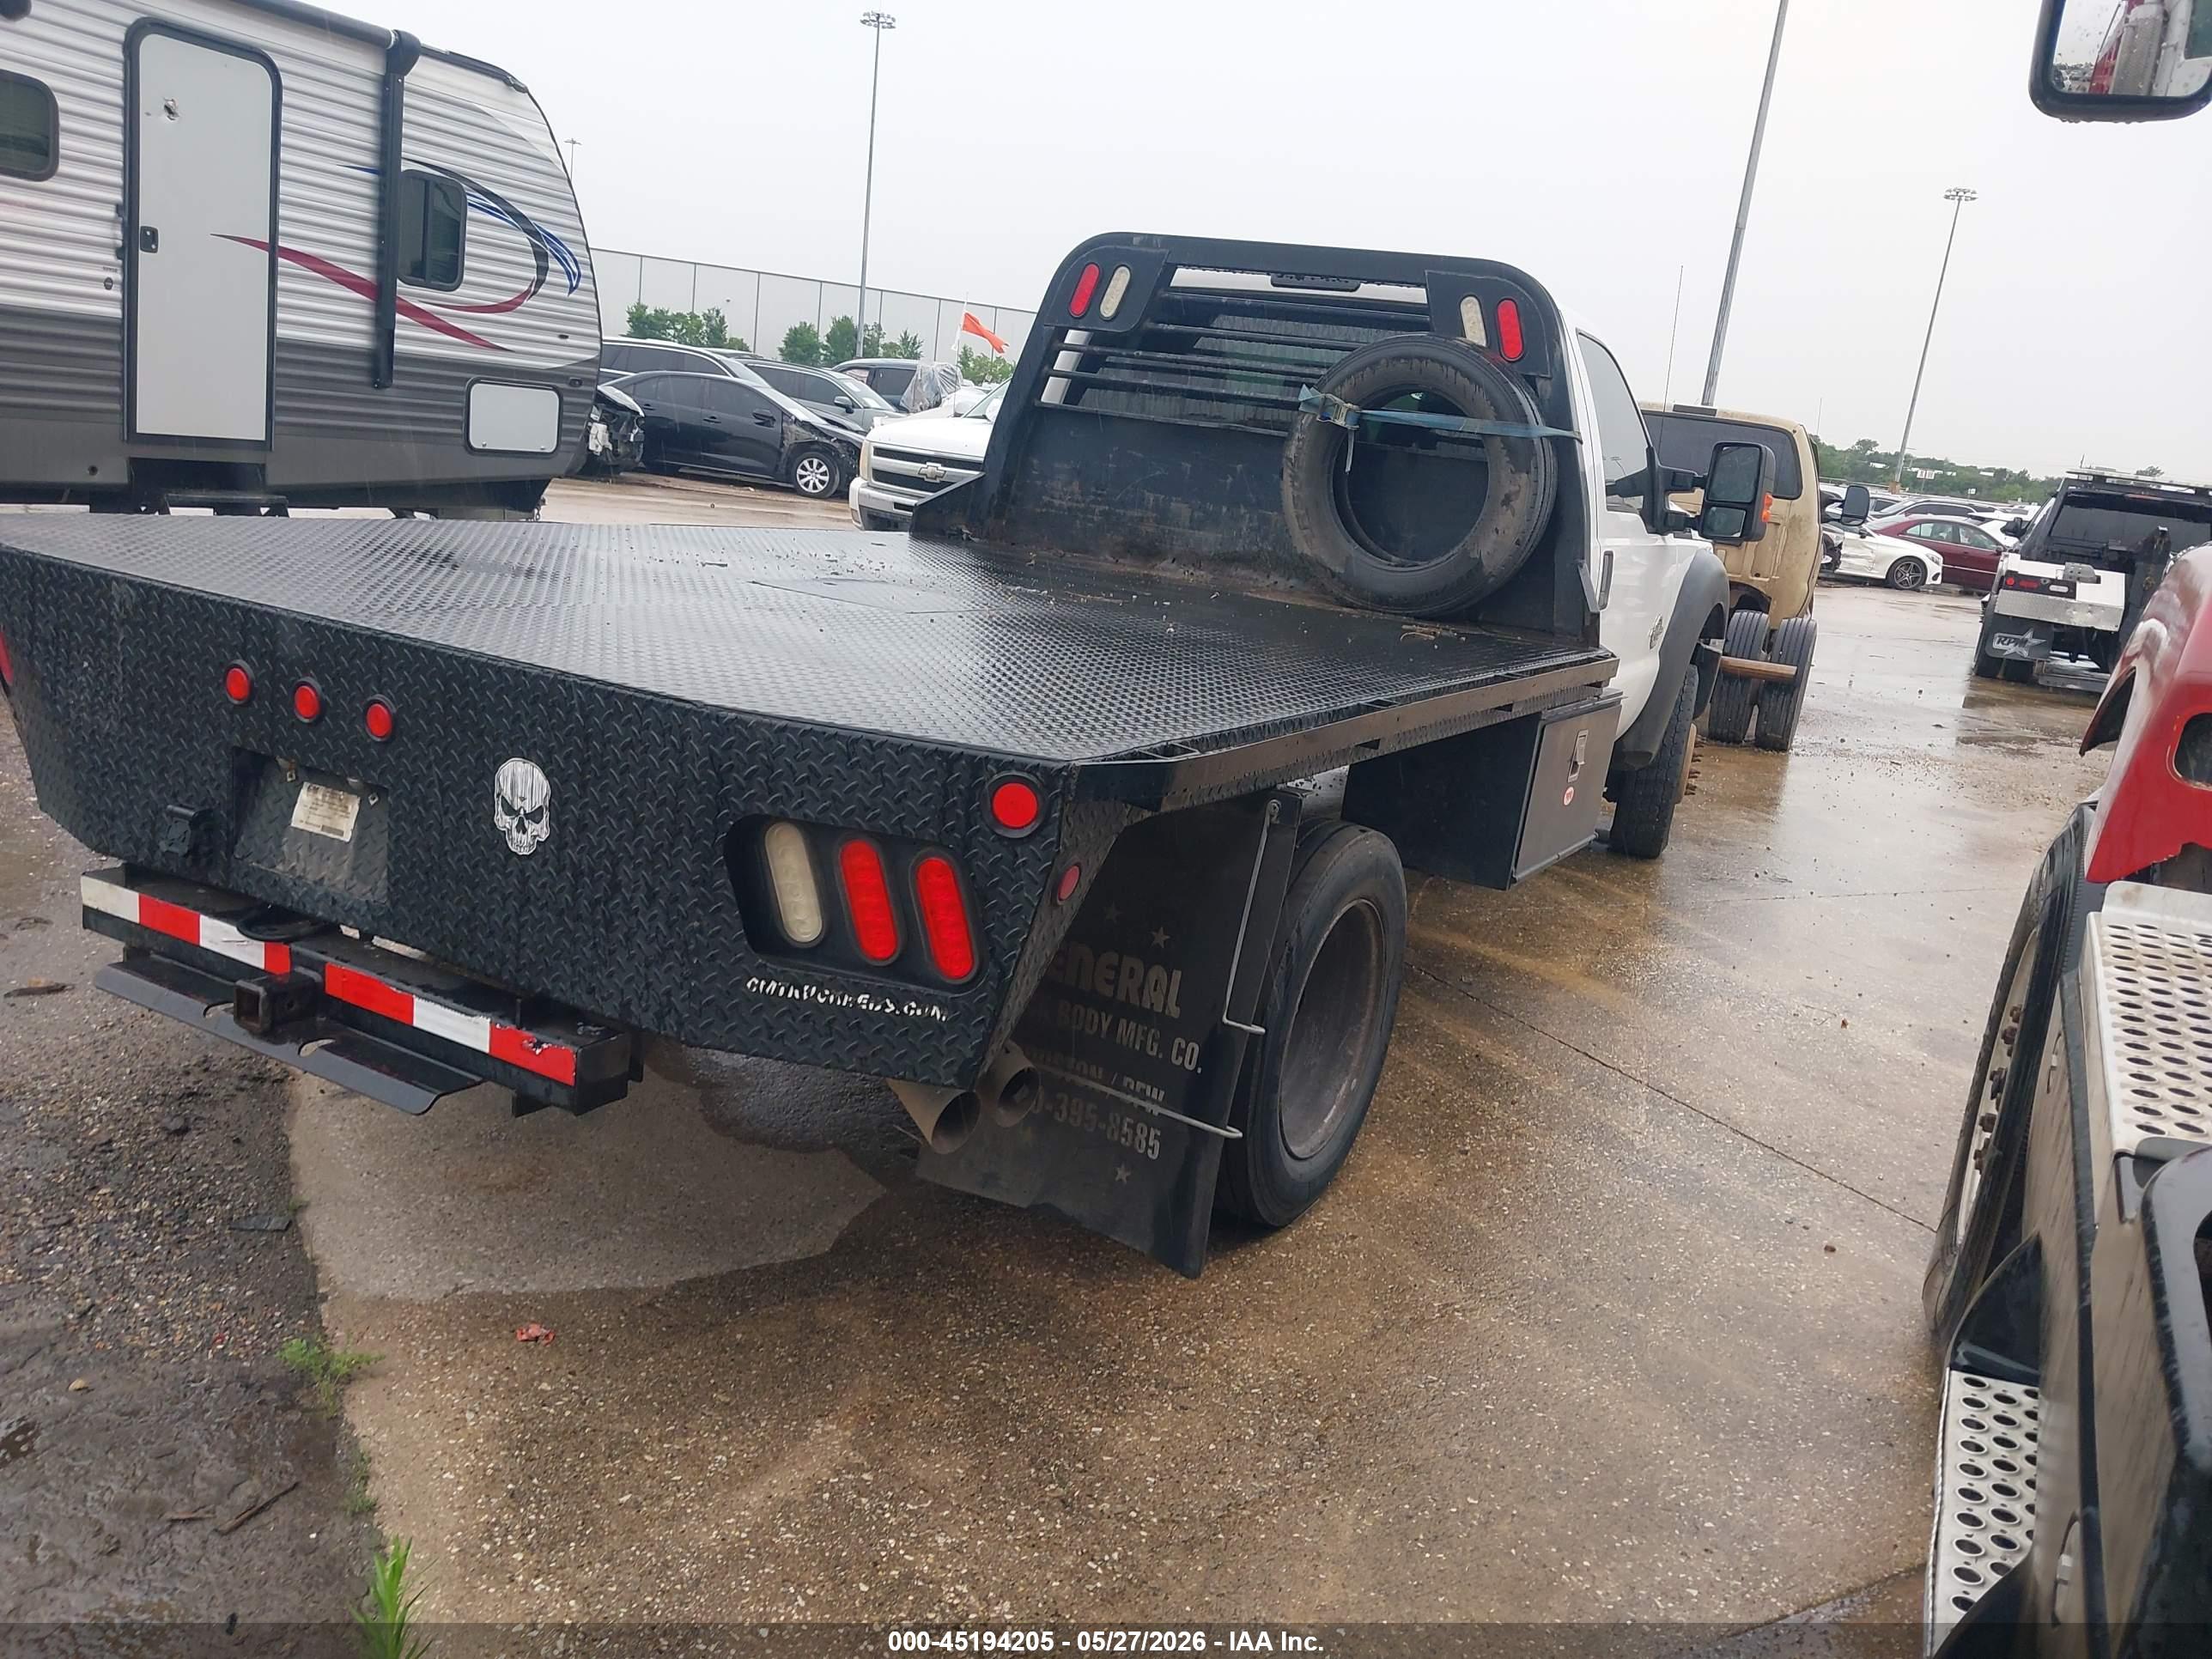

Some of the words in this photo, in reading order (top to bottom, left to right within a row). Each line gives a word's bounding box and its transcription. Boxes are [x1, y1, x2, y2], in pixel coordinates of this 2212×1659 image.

[1047, 941, 1182, 1018] ENERAL
[1057, 1000, 1113, 1038] BODY
[1116, 1018, 1163, 1059] MFG.
[1171, 1037, 1202, 1073] CO.
[1030, 1085, 1161, 1160] 0-395-8585
